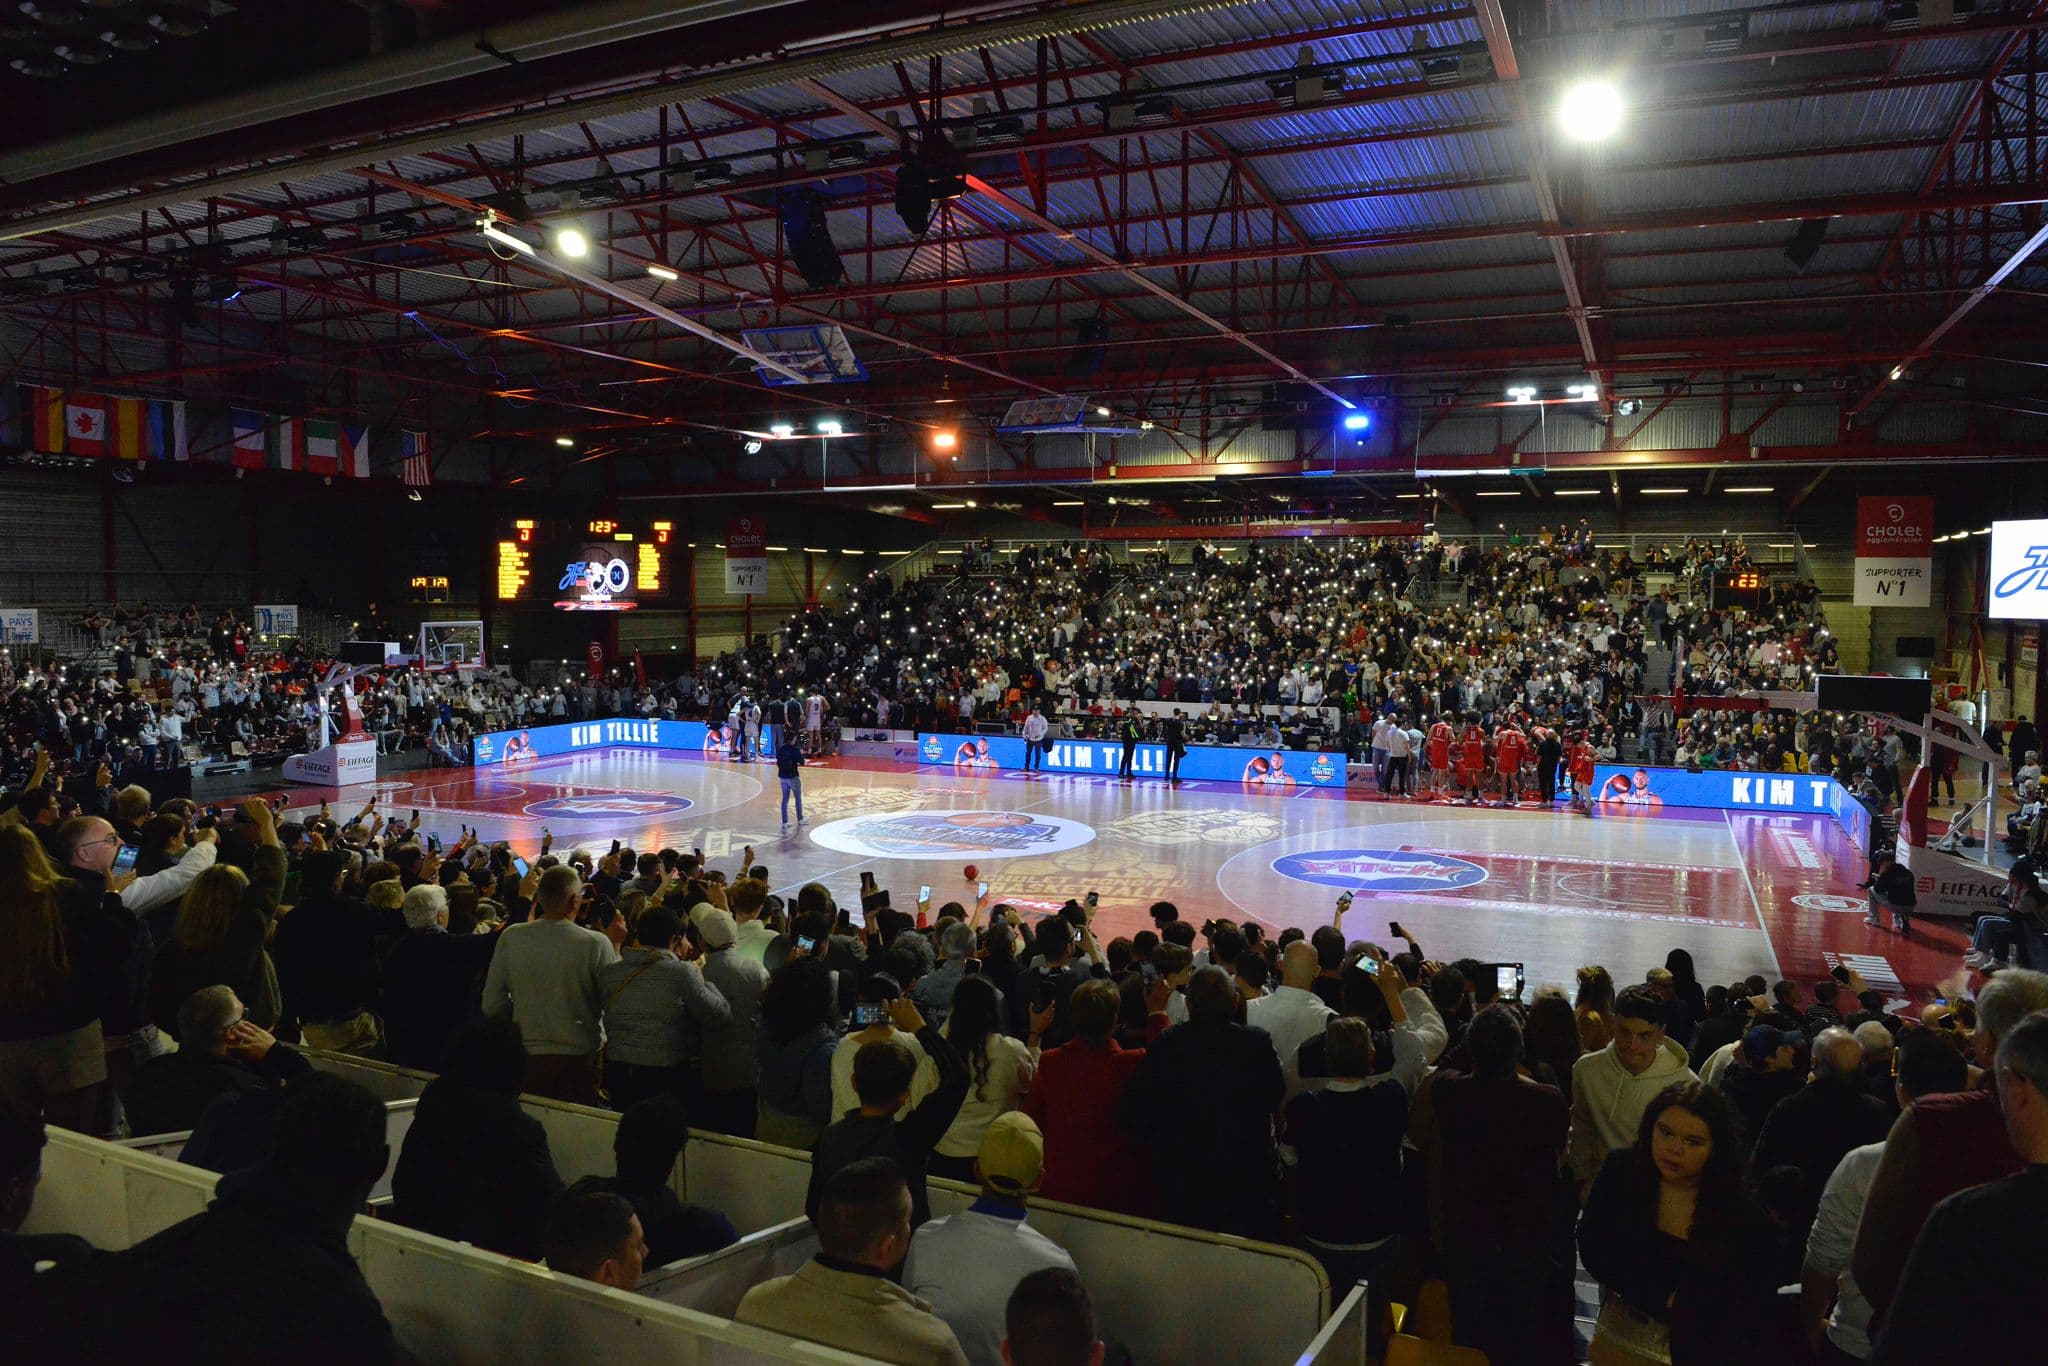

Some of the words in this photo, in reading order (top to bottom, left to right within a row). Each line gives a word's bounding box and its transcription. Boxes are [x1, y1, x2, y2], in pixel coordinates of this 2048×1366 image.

[1865, 568, 1922, 578] SUPPORTER
[1877, 580, 1906, 597] N°1
[9, 617, 33, 626] PAYS
[571, 724, 601, 747] KIM
[607, 722, 659, 744] TILLIE
[347, 756, 375, 767] EIFFAGE
[1047, 744, 1092, 769] KIM
[304, 763, 331, 774] EIFFAGE
[1732, 777, 1795, 806] KIM
[1940, 882, 2002, 898] EIFFAG
